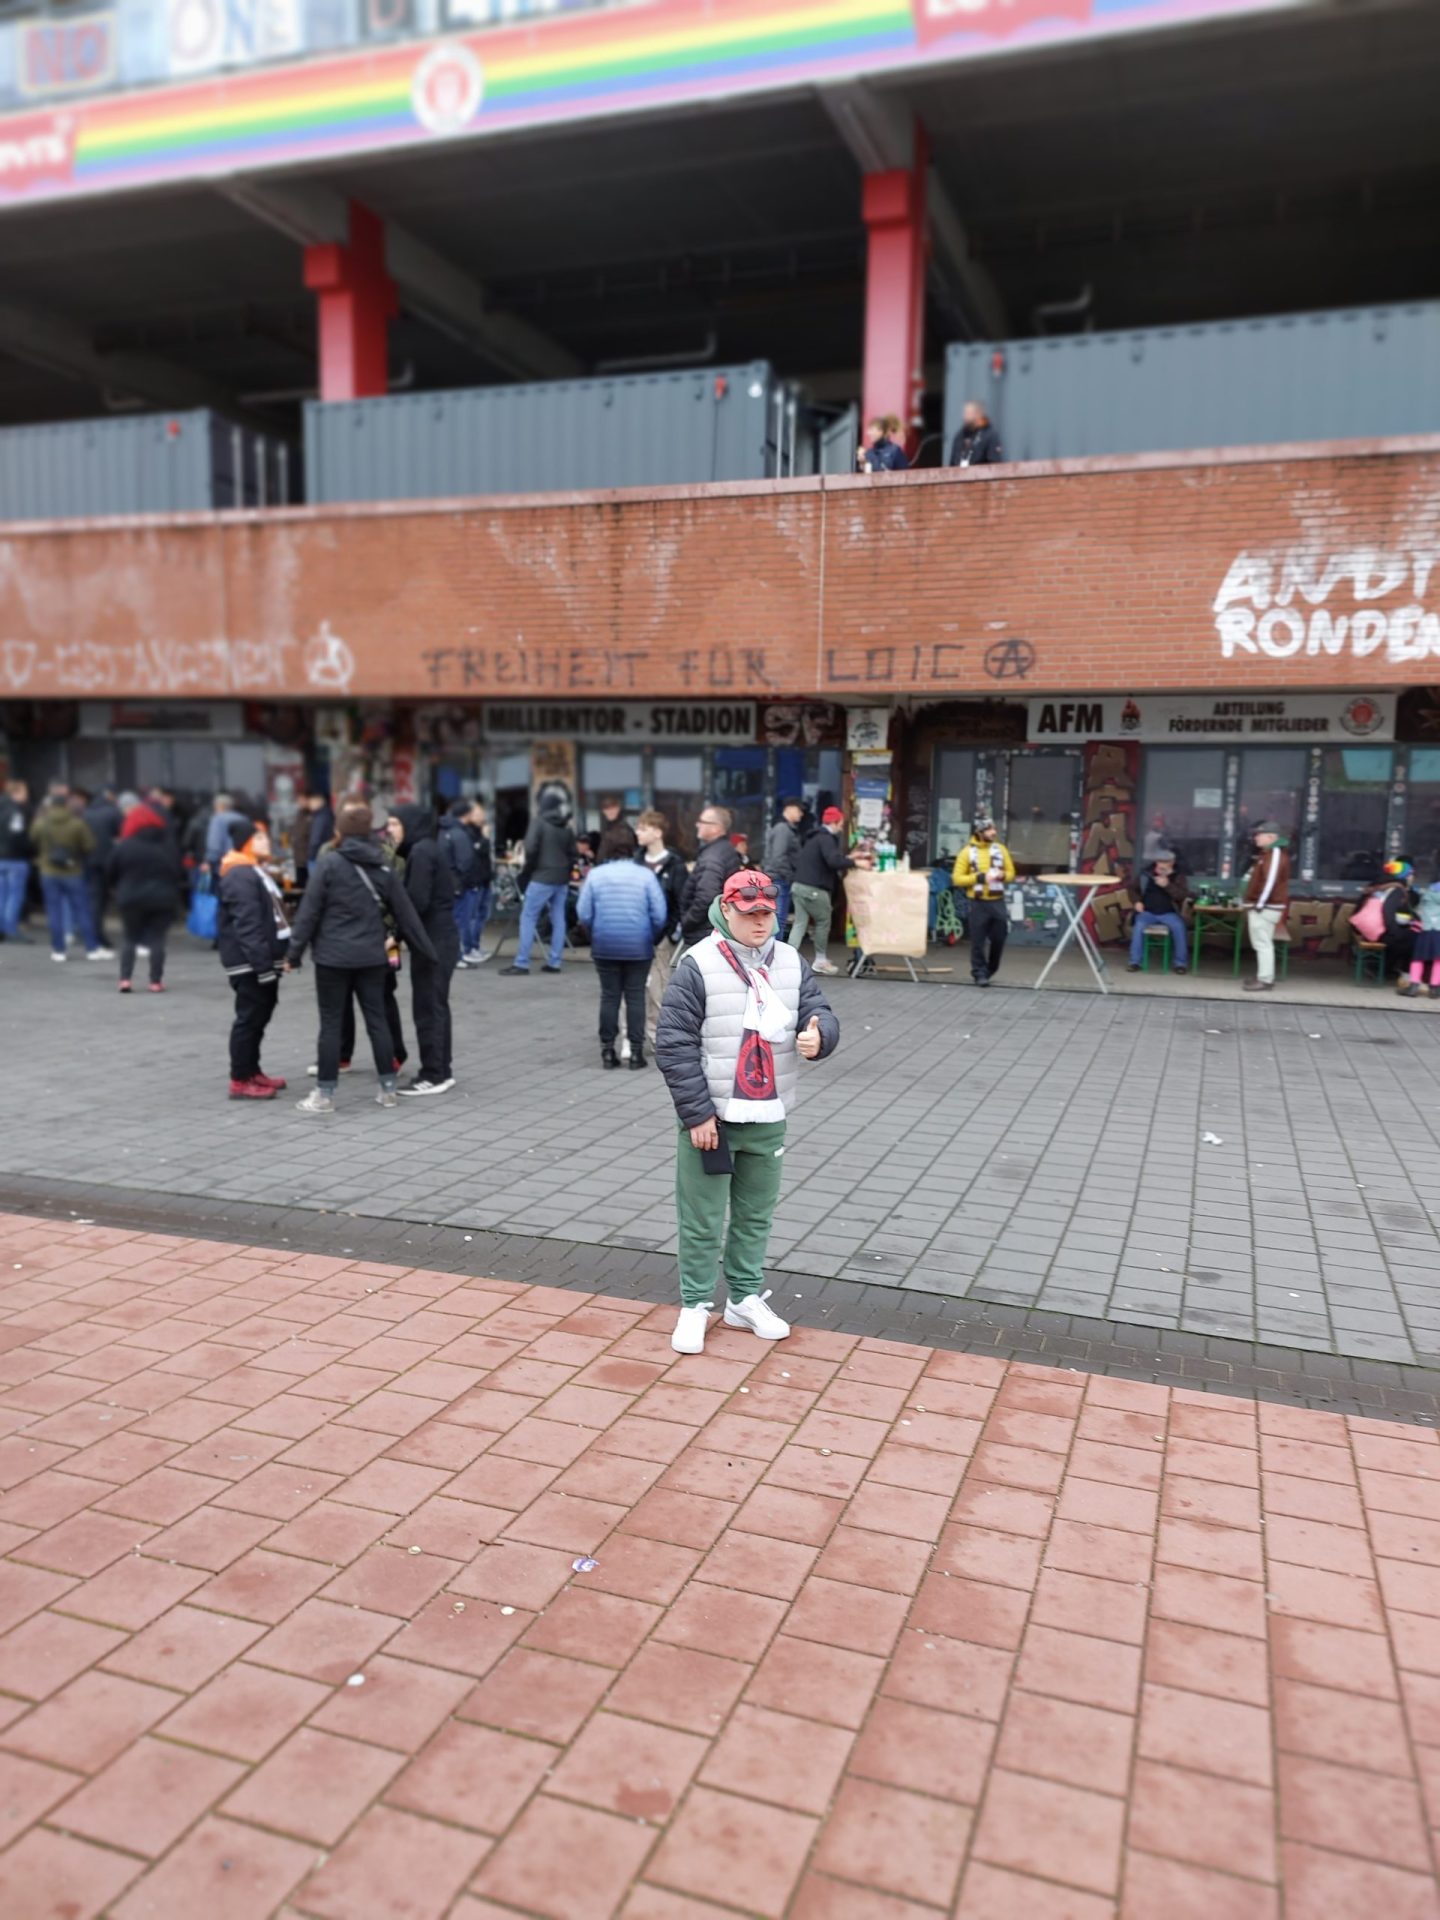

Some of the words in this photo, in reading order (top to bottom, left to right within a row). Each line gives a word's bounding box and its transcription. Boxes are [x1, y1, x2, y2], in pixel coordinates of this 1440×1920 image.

[487, 706, 625, 734] MILLERNTOR
[652, 705, 751, 735] STADION
[1037, 703, 1103, 733] AFM
[1212, 701, 1285, 716] ABTEILUNG
[1168, 714, 1244, 733] FÖRDERNDE
[1250, 717, 1330, 732] MITGLIEDER
